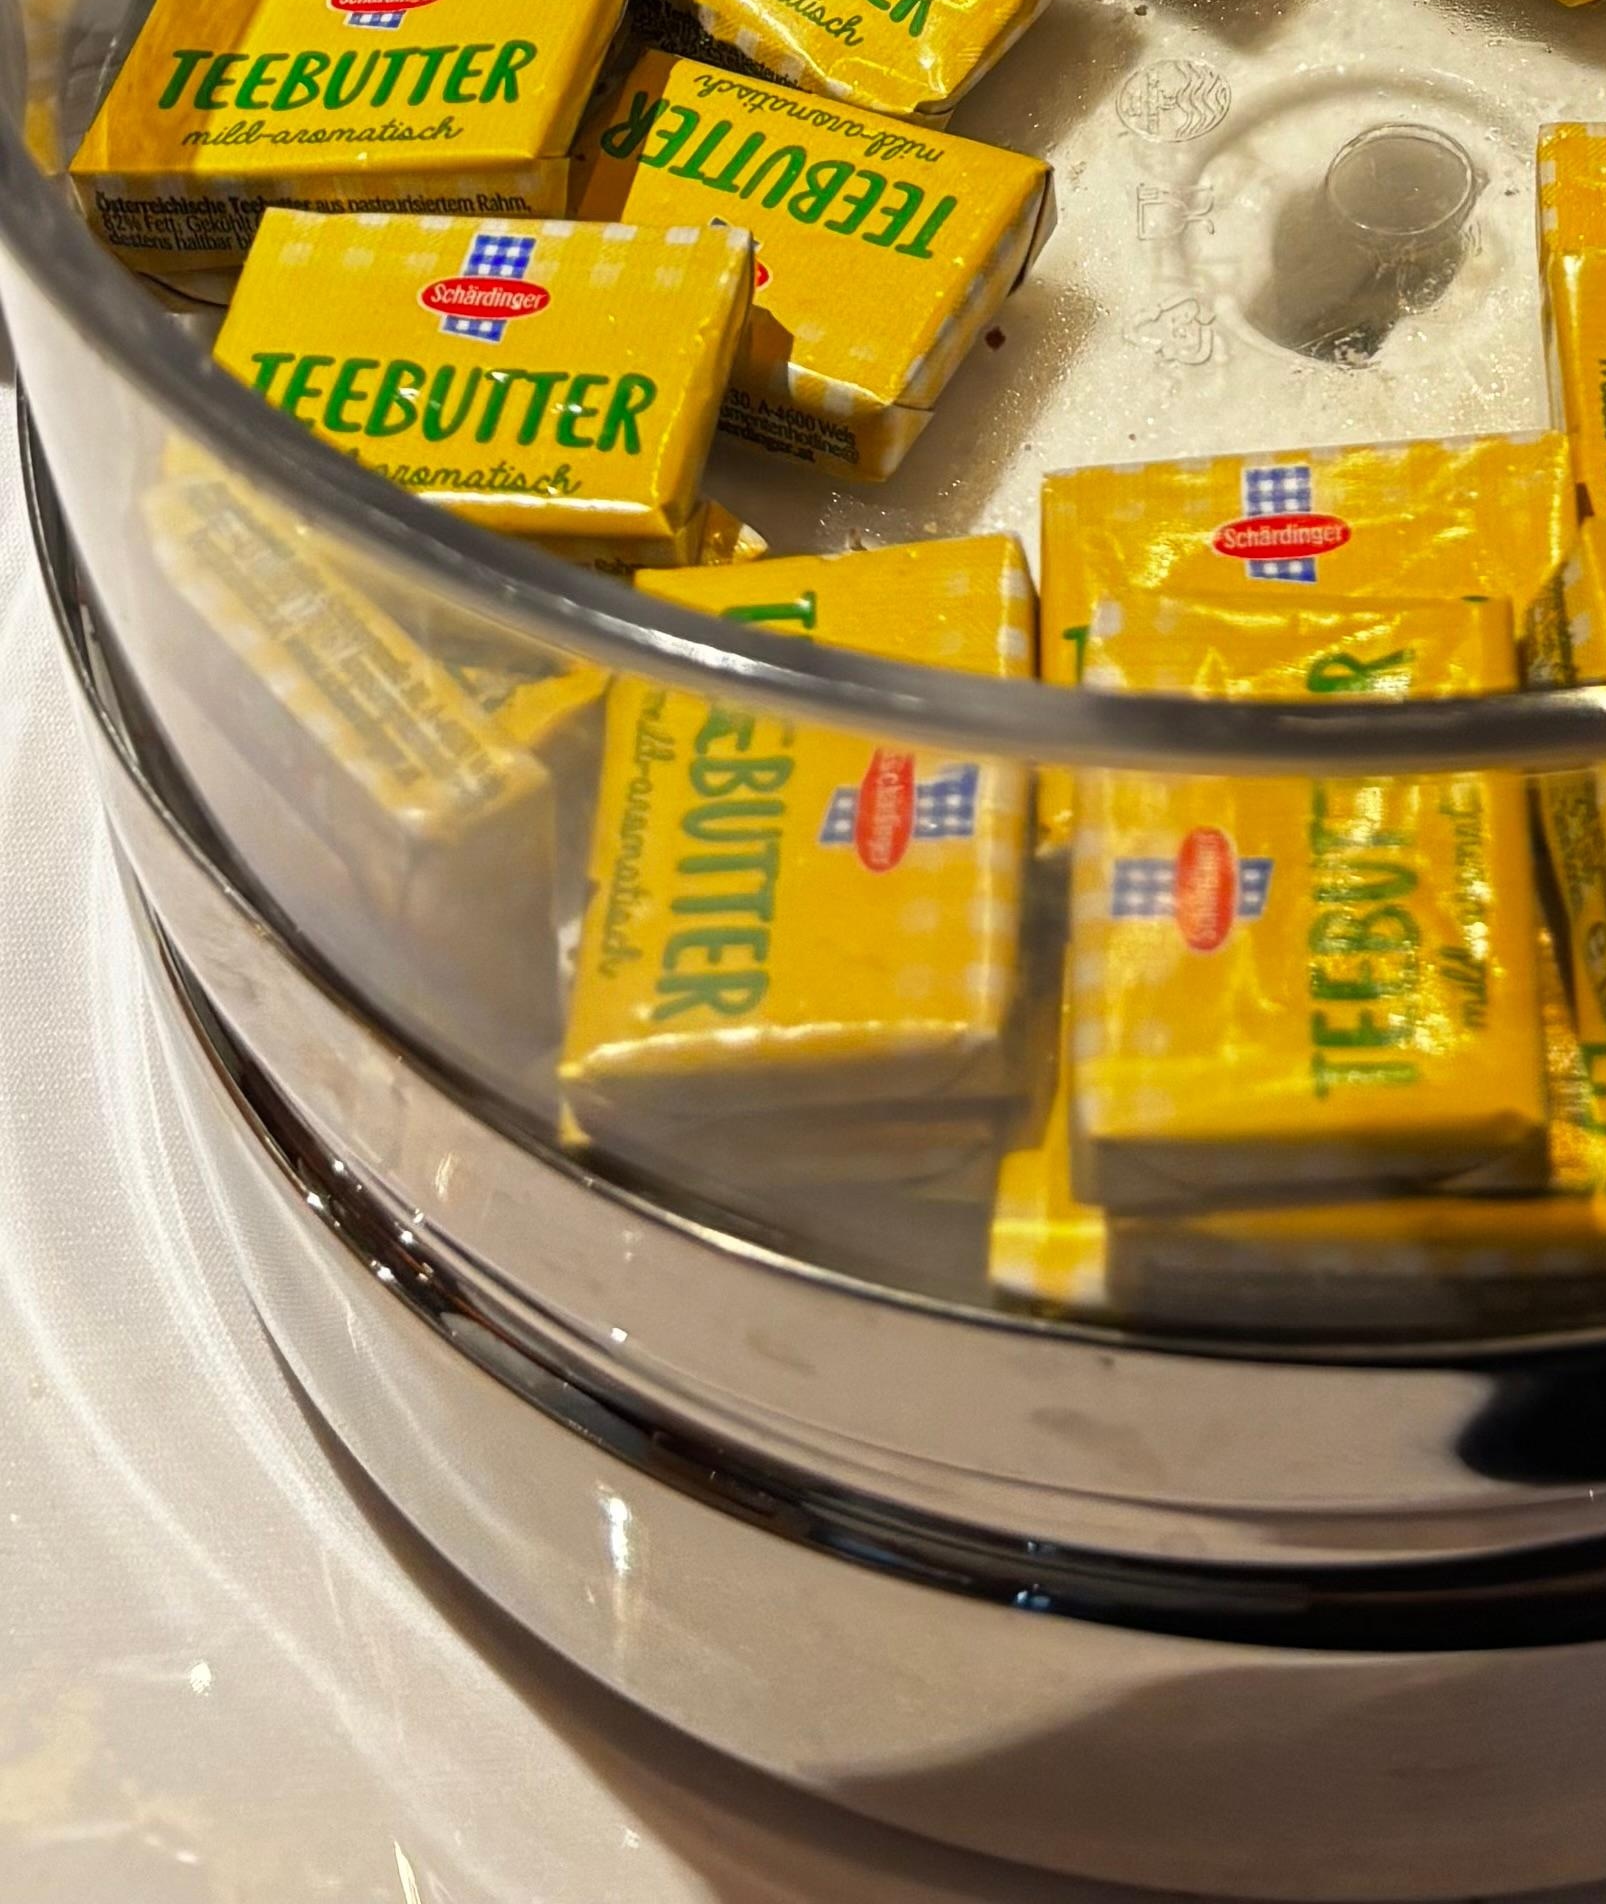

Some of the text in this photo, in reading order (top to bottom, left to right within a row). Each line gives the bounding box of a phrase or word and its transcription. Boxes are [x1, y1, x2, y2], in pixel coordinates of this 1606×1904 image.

[158, 40, 538, 111] TEEBUTTER
[181, 116, 464, 147] mild-aromatisch
[695, 73, 945, 163] mild-aromatisch
[601, 90, 958, 260] TEEBUTTER
[94, 191, 226, 219] Österreichische
[477, 192, 531, 215] Rahm,
[429, 281, 546, 310] Schärdinger
[250, 352, 658, 455] TEEBUTTER
[1222, 521, 1344, 550] Schärdinger
